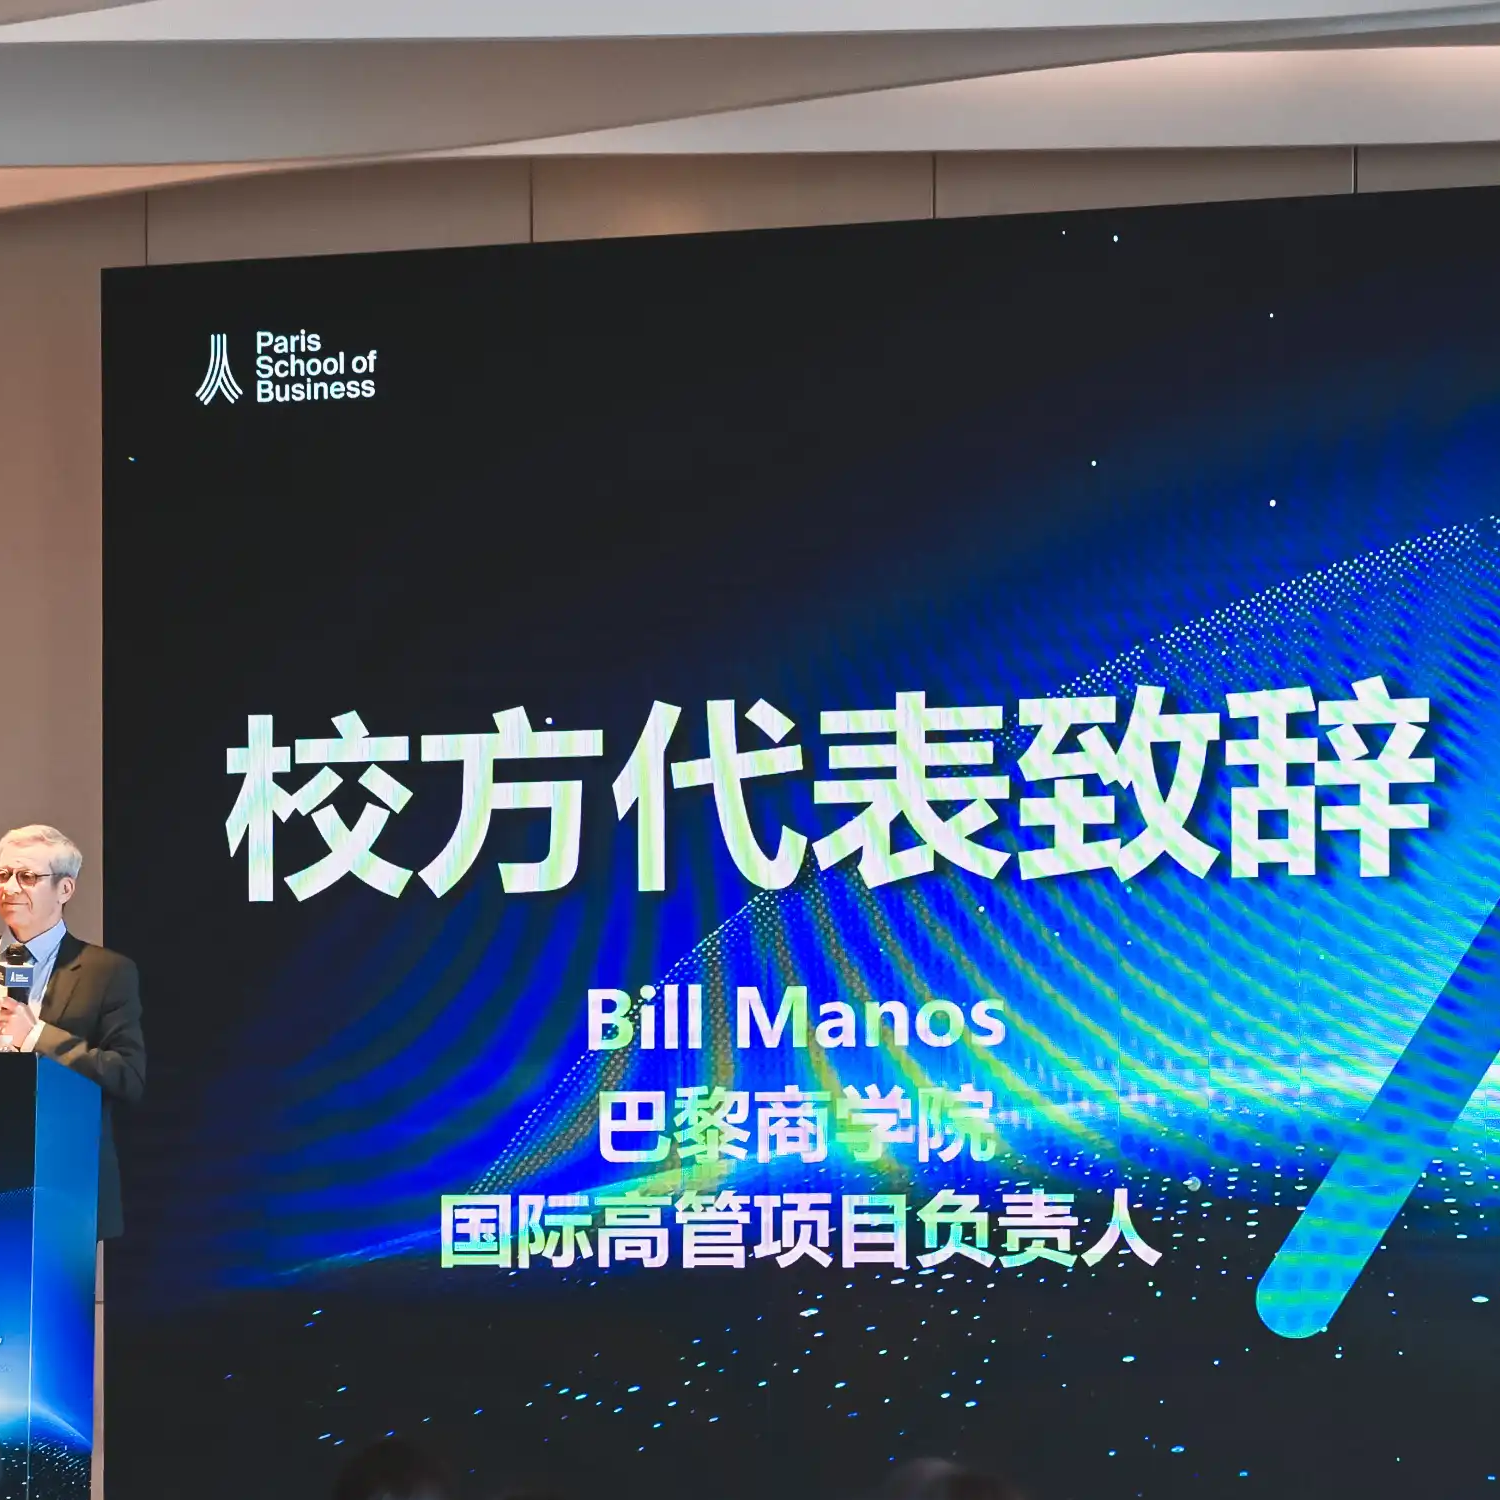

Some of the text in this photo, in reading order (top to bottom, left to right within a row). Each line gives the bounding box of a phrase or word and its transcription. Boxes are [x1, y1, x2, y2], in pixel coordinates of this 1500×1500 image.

[256, 329, 322, 354] Paris
[256, 350, 377, 378] School of
[256, 378, 376, 403] Business
[225, 676, 1436, 902] 校方代表致辞
[587, 985, 1006, 1051] Bill Manos
[598, 1085, 996, 1165] 巴黎商学院
[440, 1189, 1164, 1269] 国际高管项目负责人
